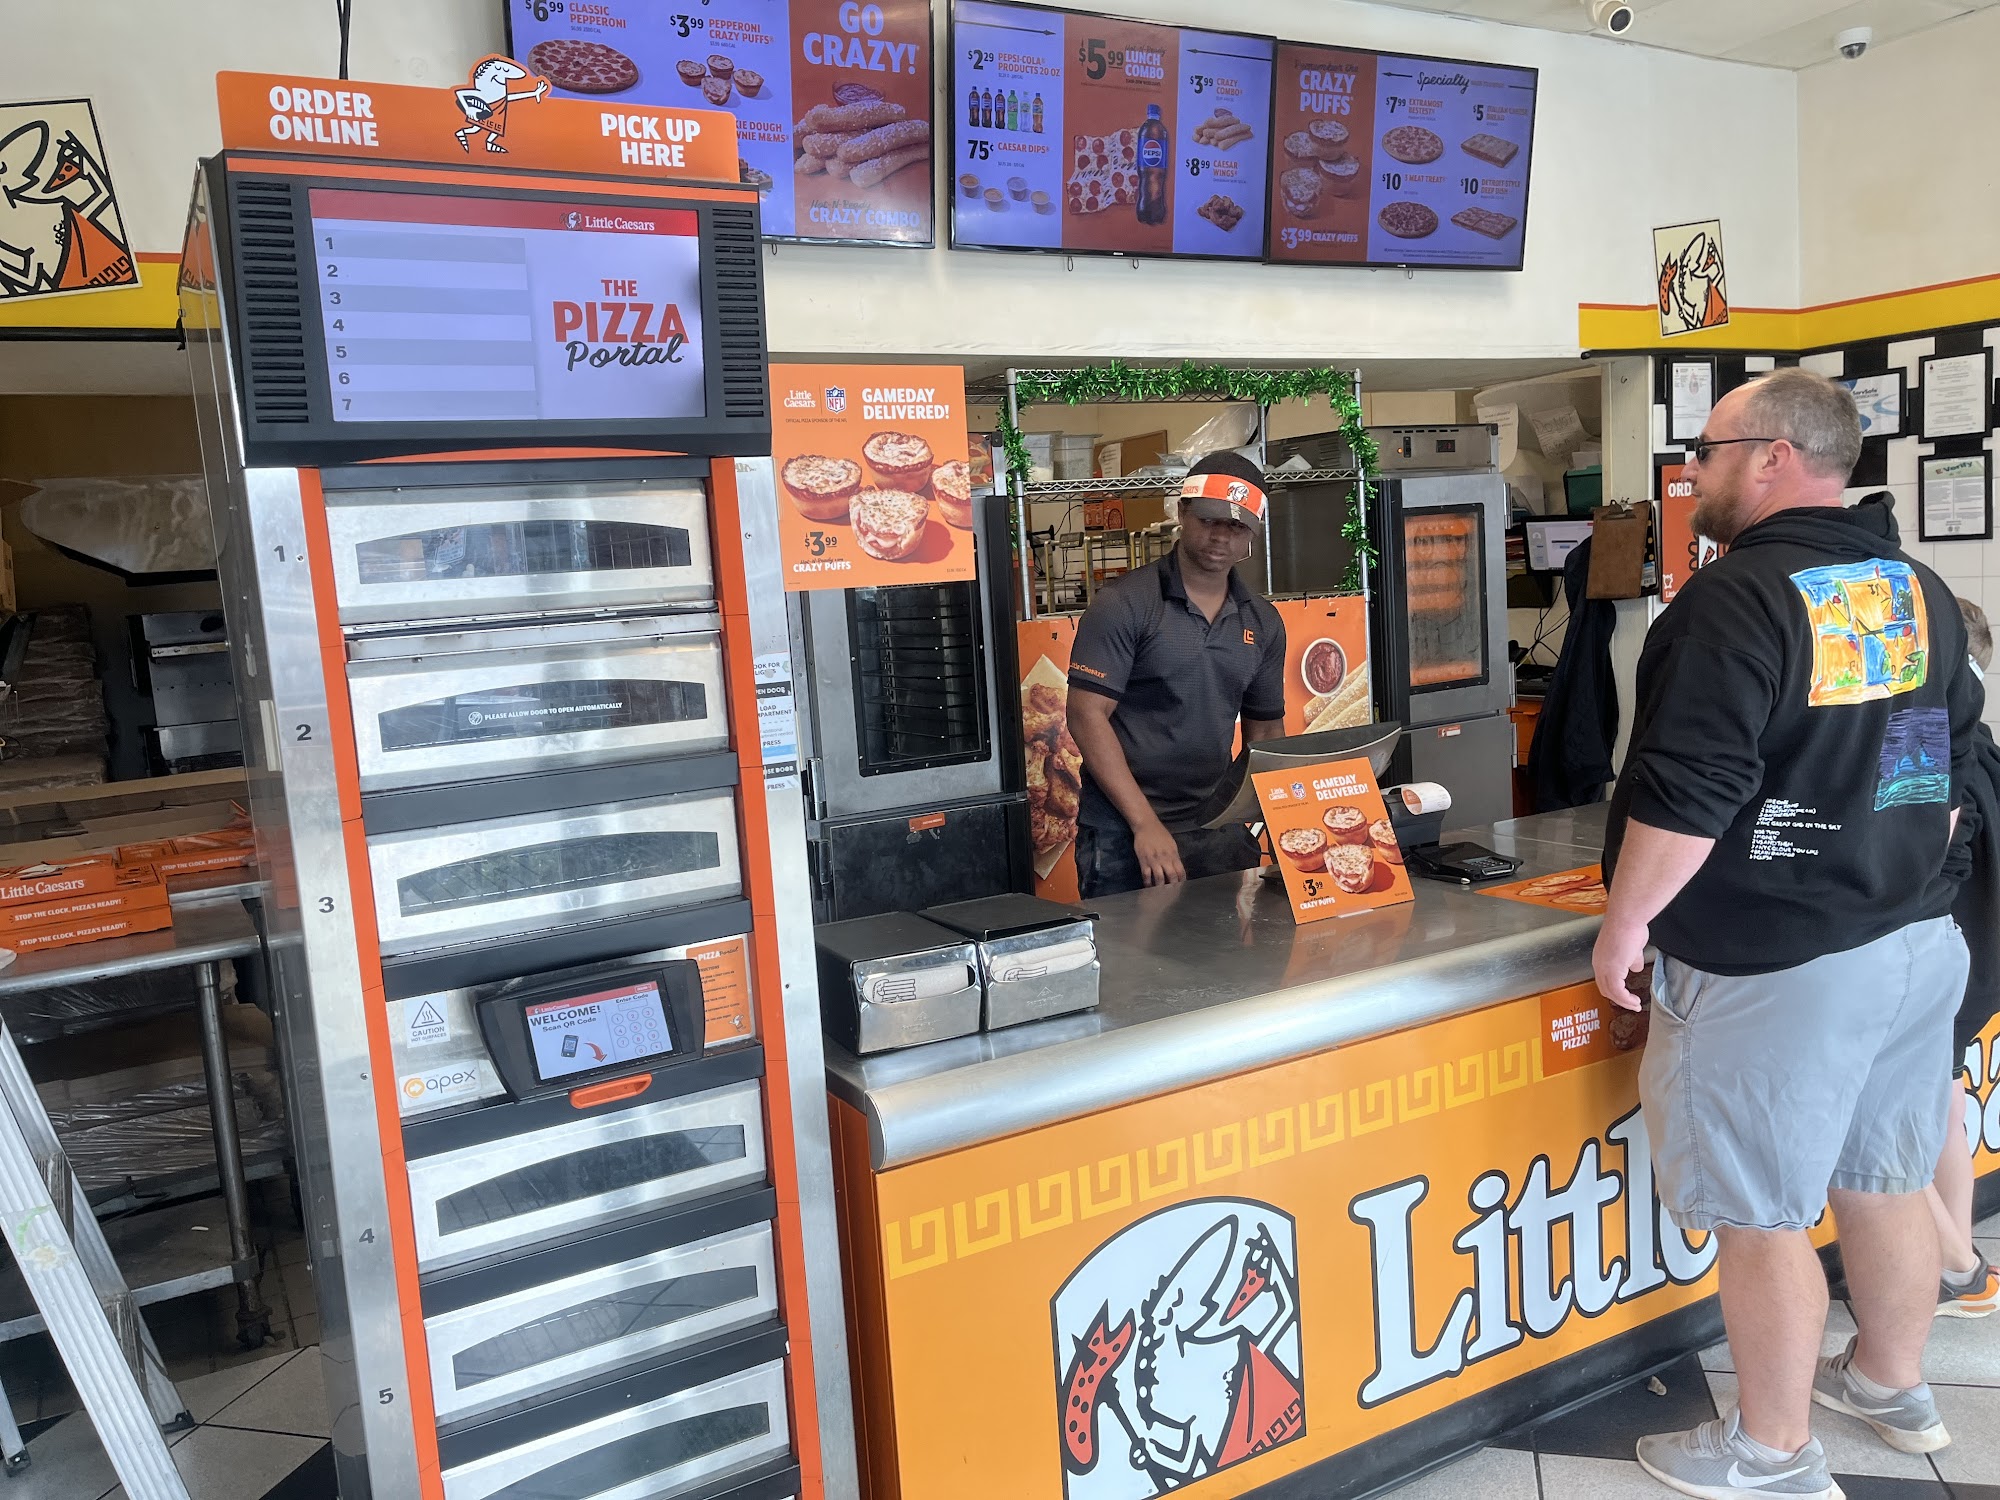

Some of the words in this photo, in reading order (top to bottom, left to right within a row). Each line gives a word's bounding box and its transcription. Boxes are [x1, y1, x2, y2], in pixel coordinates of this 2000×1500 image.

[569, 2, 610, 16] CLASSIC
[570, 14, 627, 29] PEPPERONI
[708, 19, 761, 33] PEPPERONI
[838, 0, 884, 36] GO
[709, 29, 740, 41] CRAZY
[803, 32, 916, 75] CRAZY!
[1125, 50, 1161, 66] LUNCH
[998, 63, 1039, 74] PRODUCTS
[1040, 67, 1049, 75] 20
[1051, 68, 1060, 76] OZ
[1125, 63, 1164, 80] COMBO
[1216, 78, 1238, 87] CRAZY
[1299, 69, 1356, 93] CRAZY
[1417, 71, 1470, 94] Specialty
[269, 85, 374, 118] ORDER
[1473, 104, 1484, 121] $5
[269, 115, 379, 148] ONLINE
[601, 112, 657, 141] PICK
[667, 117, 700, 142] UP
[749, 121, 782, 132] DOUGH
[620, 141, 685, 168] HERE
[968, 139, 994, 161] 75¢
[997, 142, 1027, 152] CAESAR
[1213, 160, 1238, 169] CAESAR
[1382, 173, 1401, 190] $10
[1409, 175, 1424, 183] MEAT
[1460, 178, 1479, 195] $10
[585, 215, 613, 230] Little
[615, 217, 655, 232] Caesars
[809, 208, 863, 225] CRAZY
[866, 209, 921, 228] COMBO
[325, 237, 334, 249] 1
[1312, 232, 1337, 242] CRAZY
[1337, 233, 1359, 243] PUFFS
[327, 265, 338, 278] 2
[601, 279, 638, 297] THE
[329, 292, 341, 304] 3
[332, 319, 345, 331] 4
[552, 301, 690, 343] PIZZA
[336, 346, 347, 359] 5
[564, 332, 682, 372] Portal
[338, 372, 350, 385] 6
[784, 397, 816, 408] Caesars
[790, 390, 812, 400] Little
[828, 398, 844, 409] NFL
[861, 388, 935, 403] GAMEDAY
[342, 398, 352, 411] 7
[863, 405, 950, 420] DELIVERED!
[1668, 482, 1693, 498] ORD
[273, 546, 286, 562] 1
[793, 563, 823, 573] CRAZY
[824, 561, 852, 571] PUFFS
[767, 686, 786, 694] DOOR
[485, 712, 507, 720] PLEASE
[508, 710, 530, 718] ALLOW
[575, 702, 623, 712] AUTOMATICALLY
[295, 724, 312, 741] 2
[1312, 773, 1356, 790] GAMEDAY
[1315, 783, 1369, 801] DELIVERED!
[1814, 822, 1827, 830] THE
[0, 885, 34, 899] Little
[36, 879, 85, 894] Caesars
[15, 913, 32, 921] STOP
[72, 903, 96, 912] PIZZA'S
[97, 899, 121, 908] READY!
[318, 896, 335, 913] 3
[1300, 900, 1318, 910] CRAZY
[1318, 897, 1336, 906] PUFFS
[77, 928, 101, 936] PIZZA'S
[102, 922, 127, 931] READY!
[698, 951, 721, 961] PIZZA
[530, 1004, 601, 1027] WELCOME!
[578, 1017, 596, 1025] Code
[1552, 1015, 1573, 1030] PAIR
[1573, 1008, 1599, 1024] THEM
[412, 1026, 445, 1037] CAUTION
[422, 1032, 447, 1041] SURFACES
[1551, 1029, 1574, 1042] WITH
[1576, 1019, 1600, 1034] YOUR
[1562, 1034, 1590, 1051] PIZZA!
[425, 1069, 476, 1094] apex
[359, 1228, 375, 1244] 4
[378, 1388, 394, 1405] 5
